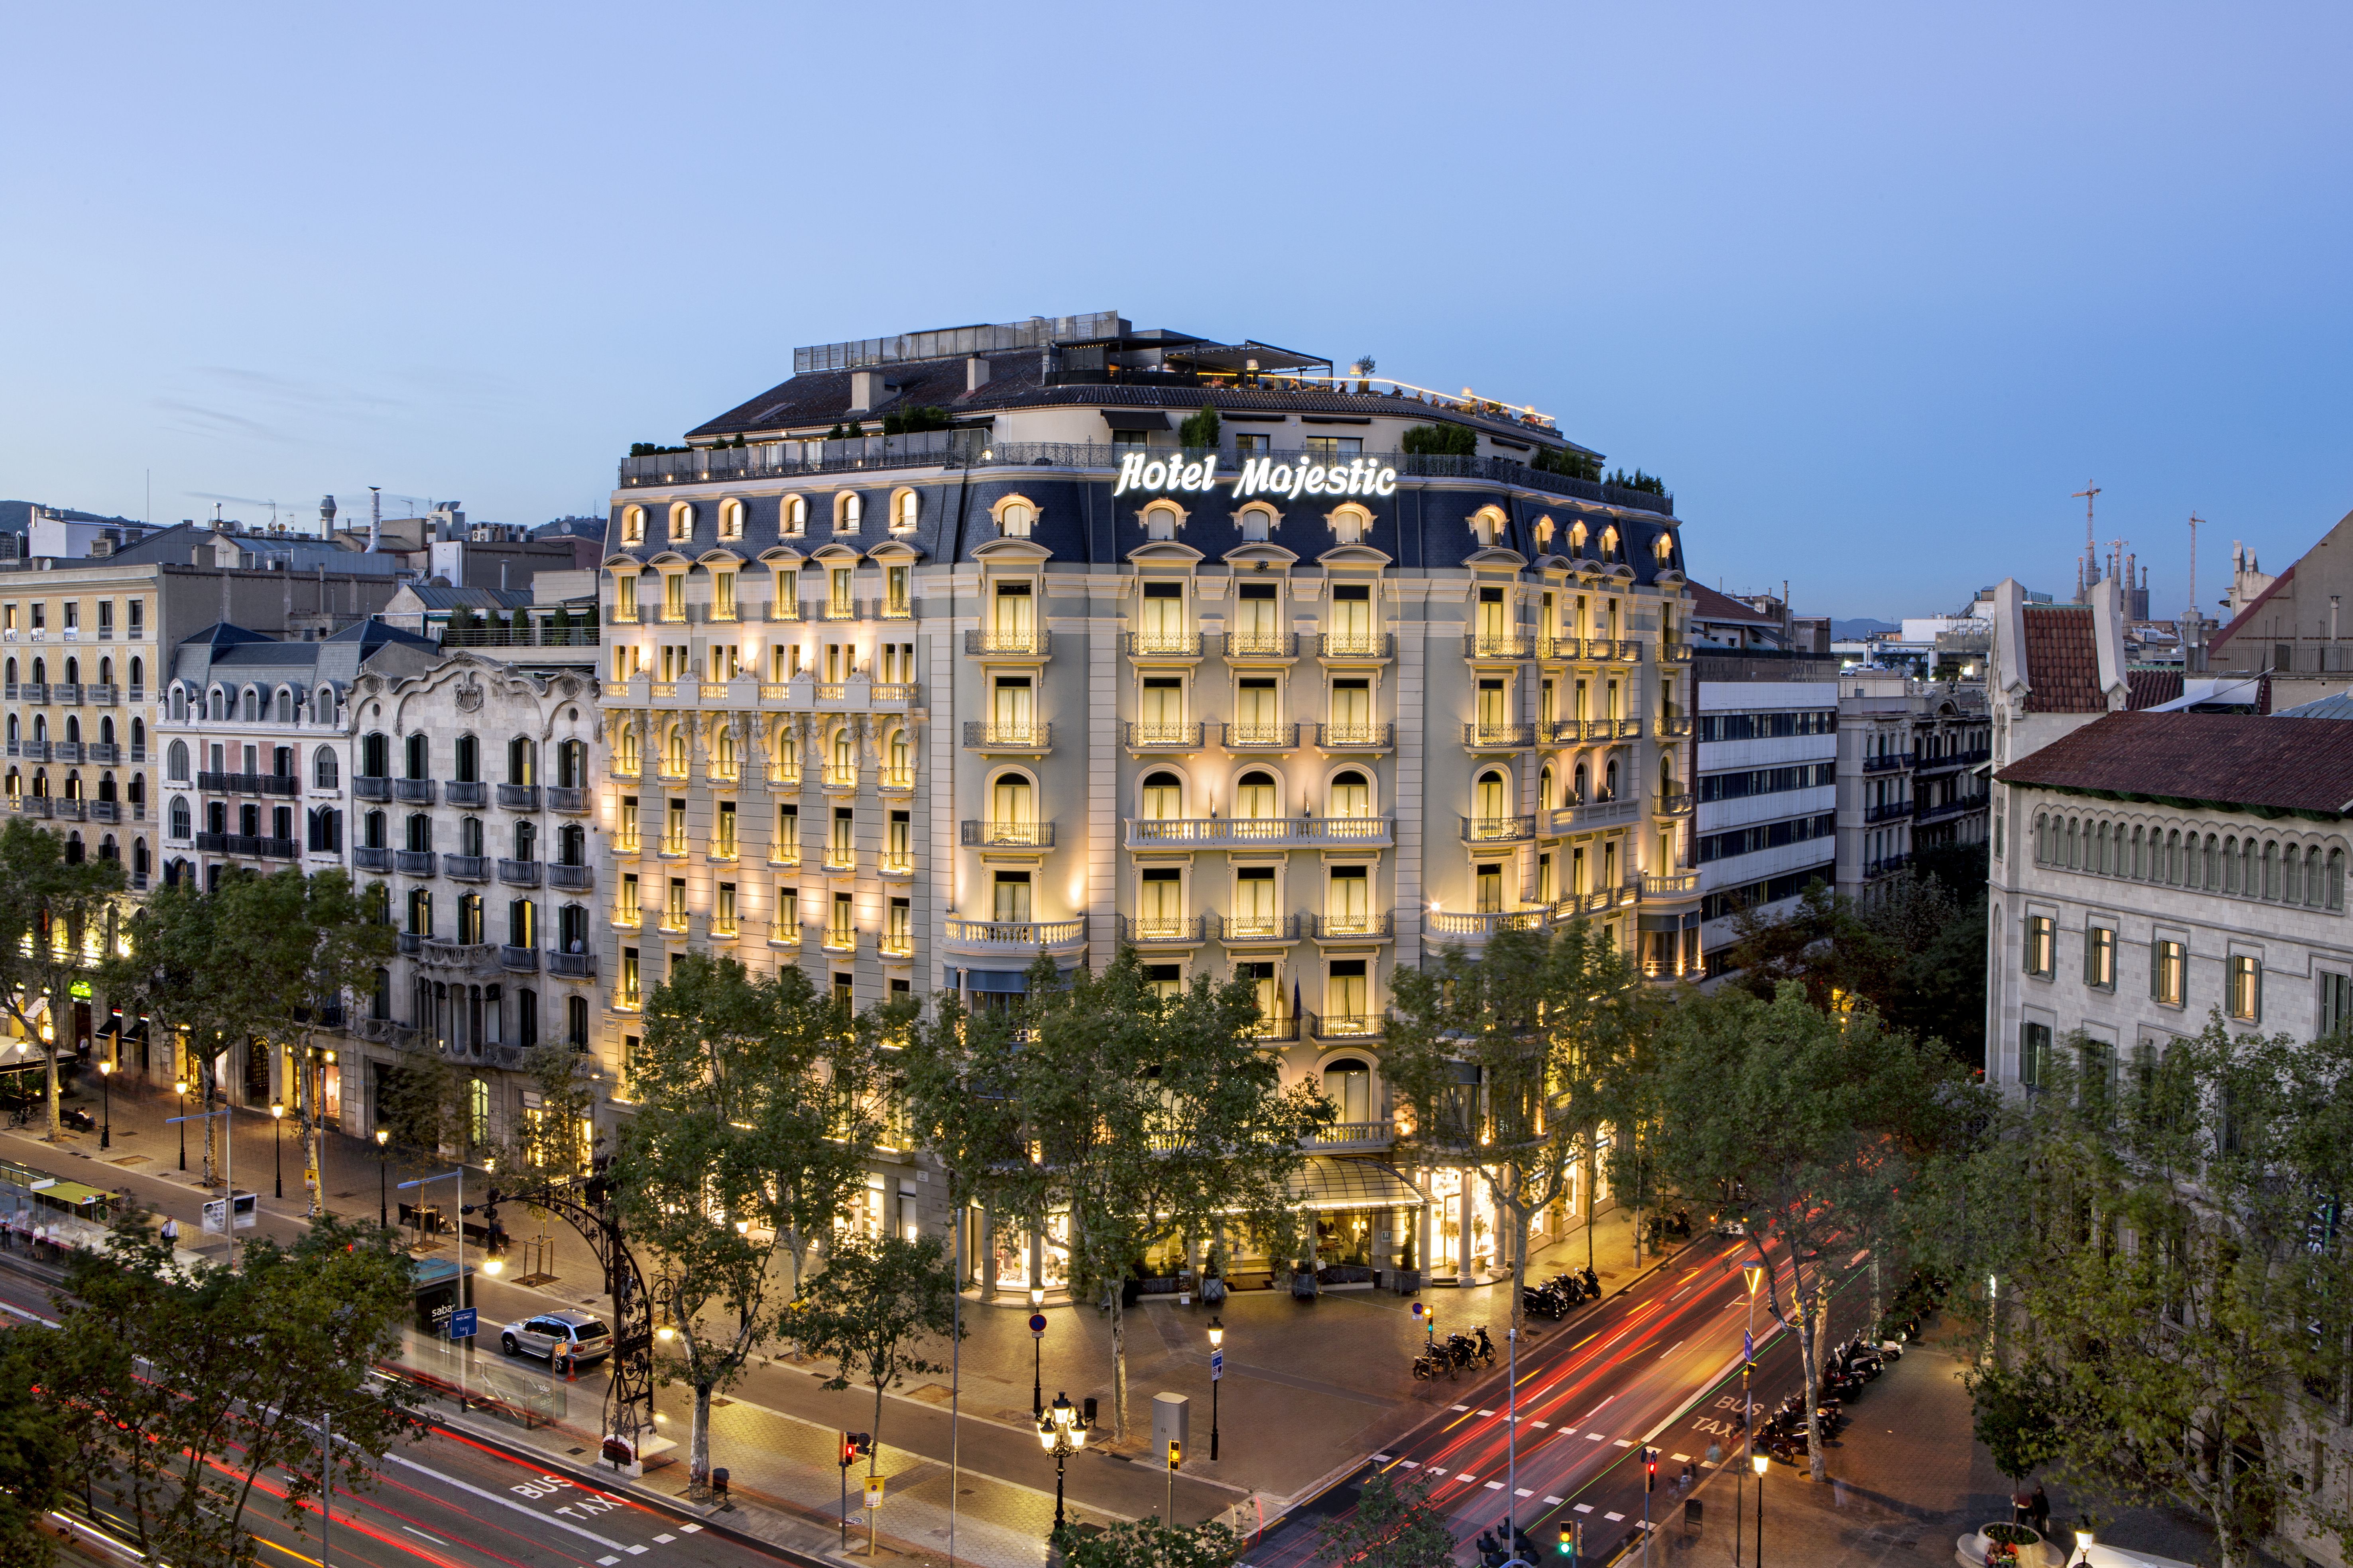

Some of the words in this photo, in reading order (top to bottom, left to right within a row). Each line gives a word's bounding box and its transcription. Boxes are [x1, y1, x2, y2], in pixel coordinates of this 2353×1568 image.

[1114, 453, 1216, 497] Hotel
[1233, 456, 1397, 500] Majestic
[1714, 1396, 1764, 1416] BUS
[1691, 1416, 1733, 1438] TAX
[510, 1475, 574, 1499] BUS
[554, 1491, 631, 1520] TAXI
